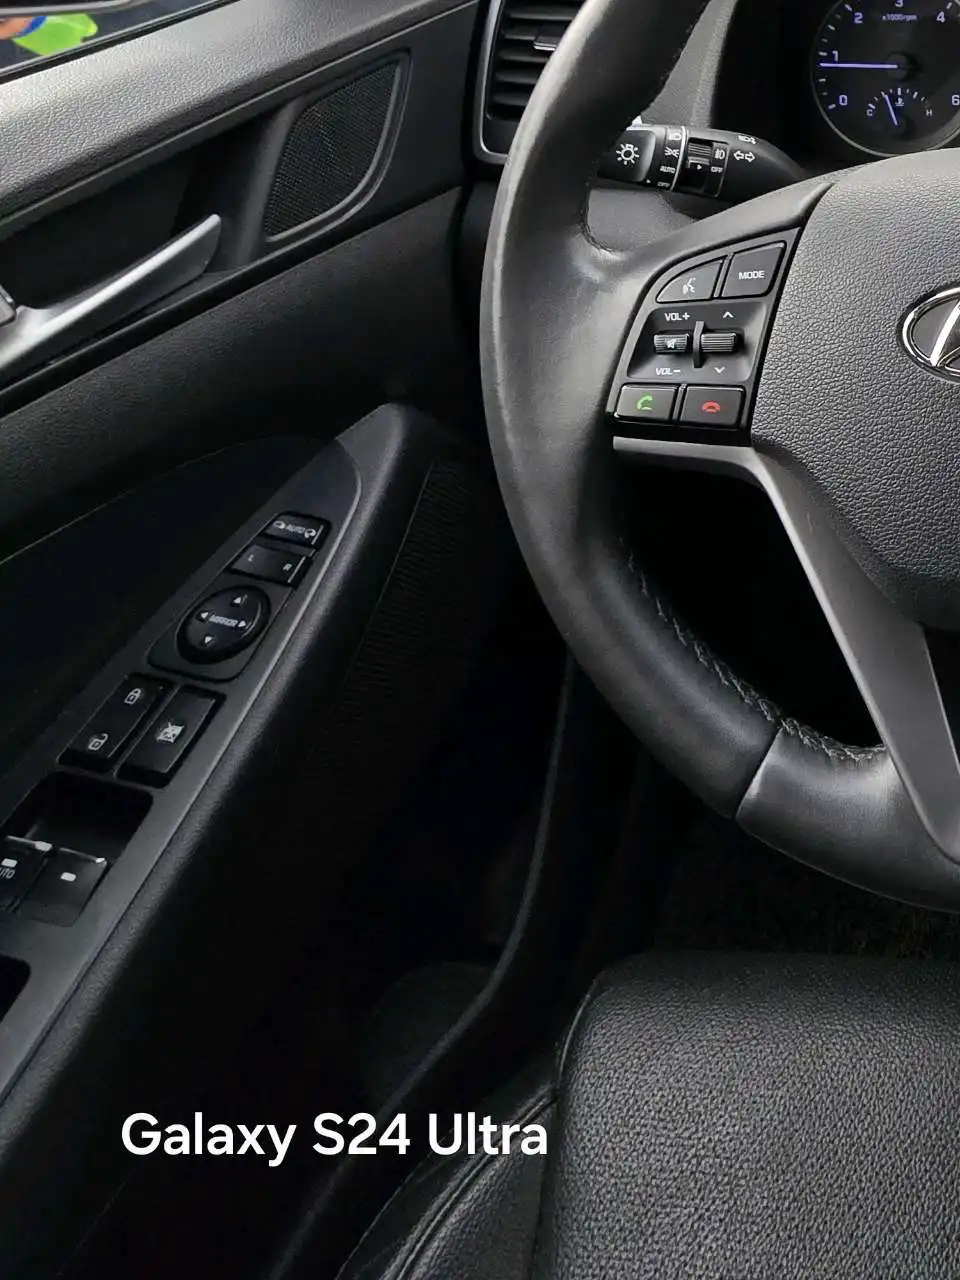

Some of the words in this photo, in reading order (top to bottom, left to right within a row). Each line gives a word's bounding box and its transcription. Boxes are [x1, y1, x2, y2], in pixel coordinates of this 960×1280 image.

[854, 12, 863, 23] 2
[936, 12, 946, 23] 4
[832, 51, 839, 61] 1
[839, 95, 848, 106] 0
[951, 95, 960, 106] 6
[866, 109, 873, 117] C
[738, 270, 765, 280] MODE
[664, 312, 690, 321] VOL+
